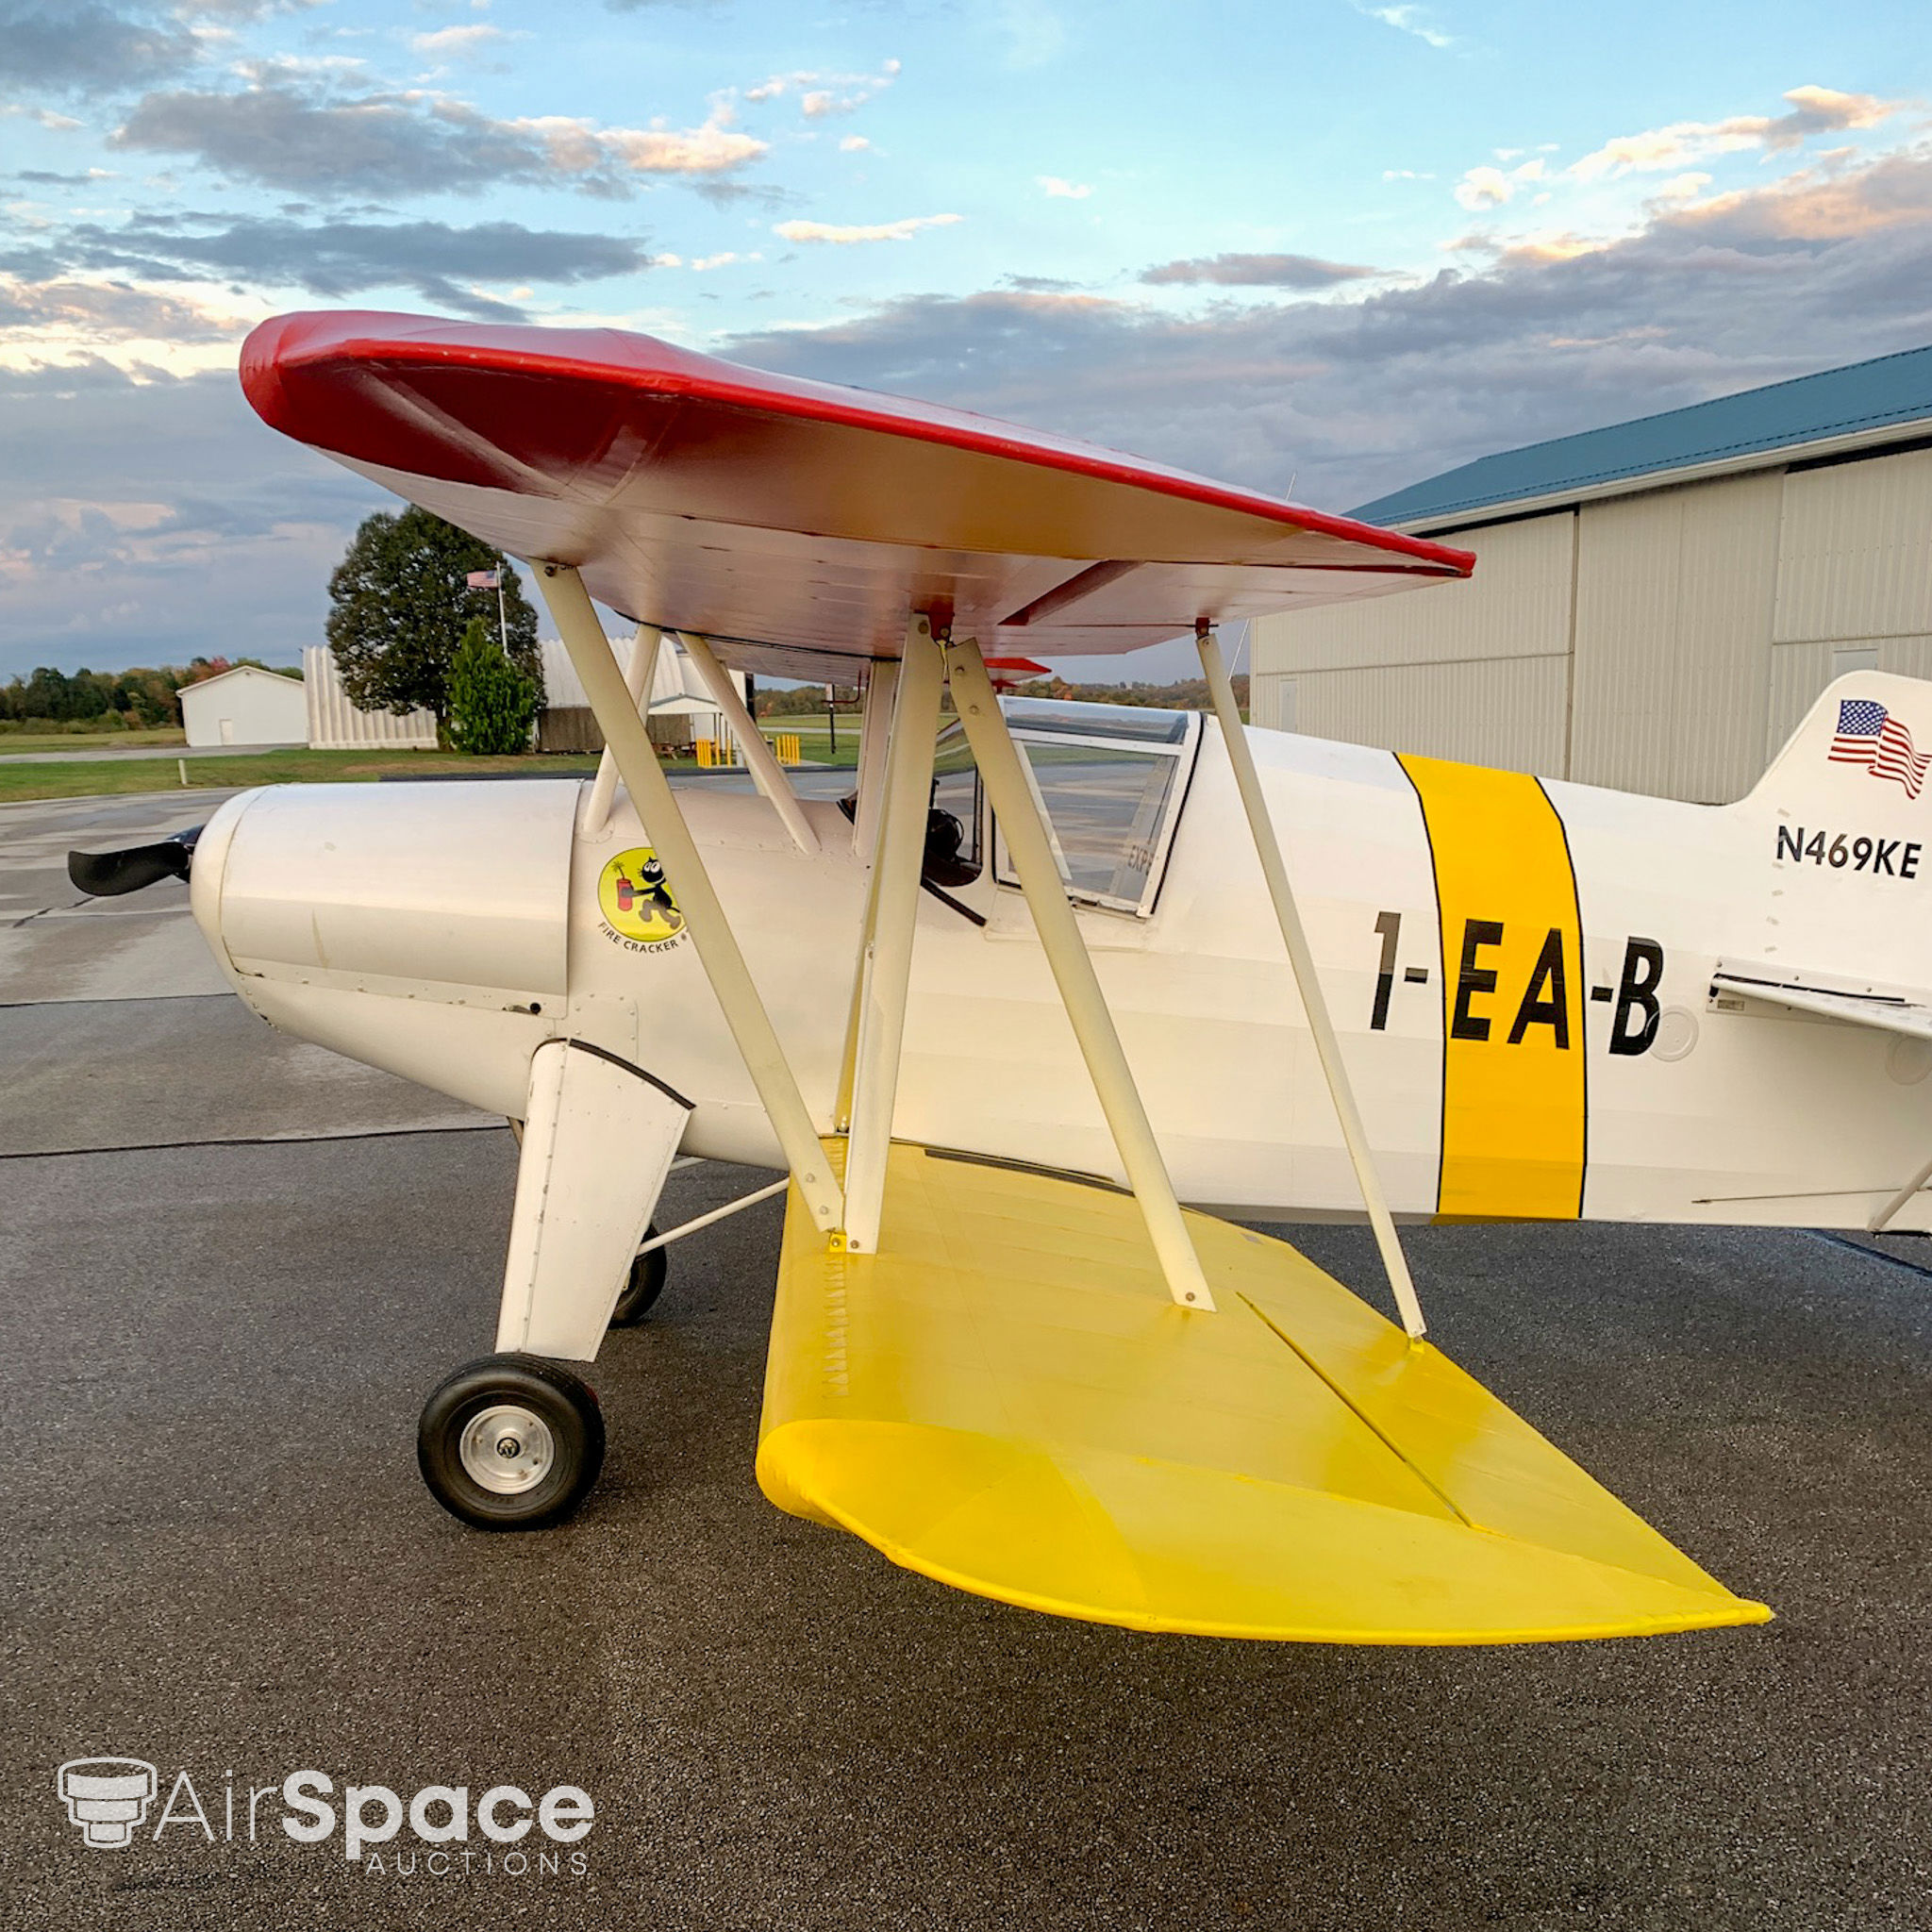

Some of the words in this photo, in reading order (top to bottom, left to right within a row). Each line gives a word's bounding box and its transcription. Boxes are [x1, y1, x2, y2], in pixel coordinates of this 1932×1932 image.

[1776, 825, 1923, 879] N469KE
[598, 921, 622, 943] FIRE
[624, 940, 679, 954] CRACKER
